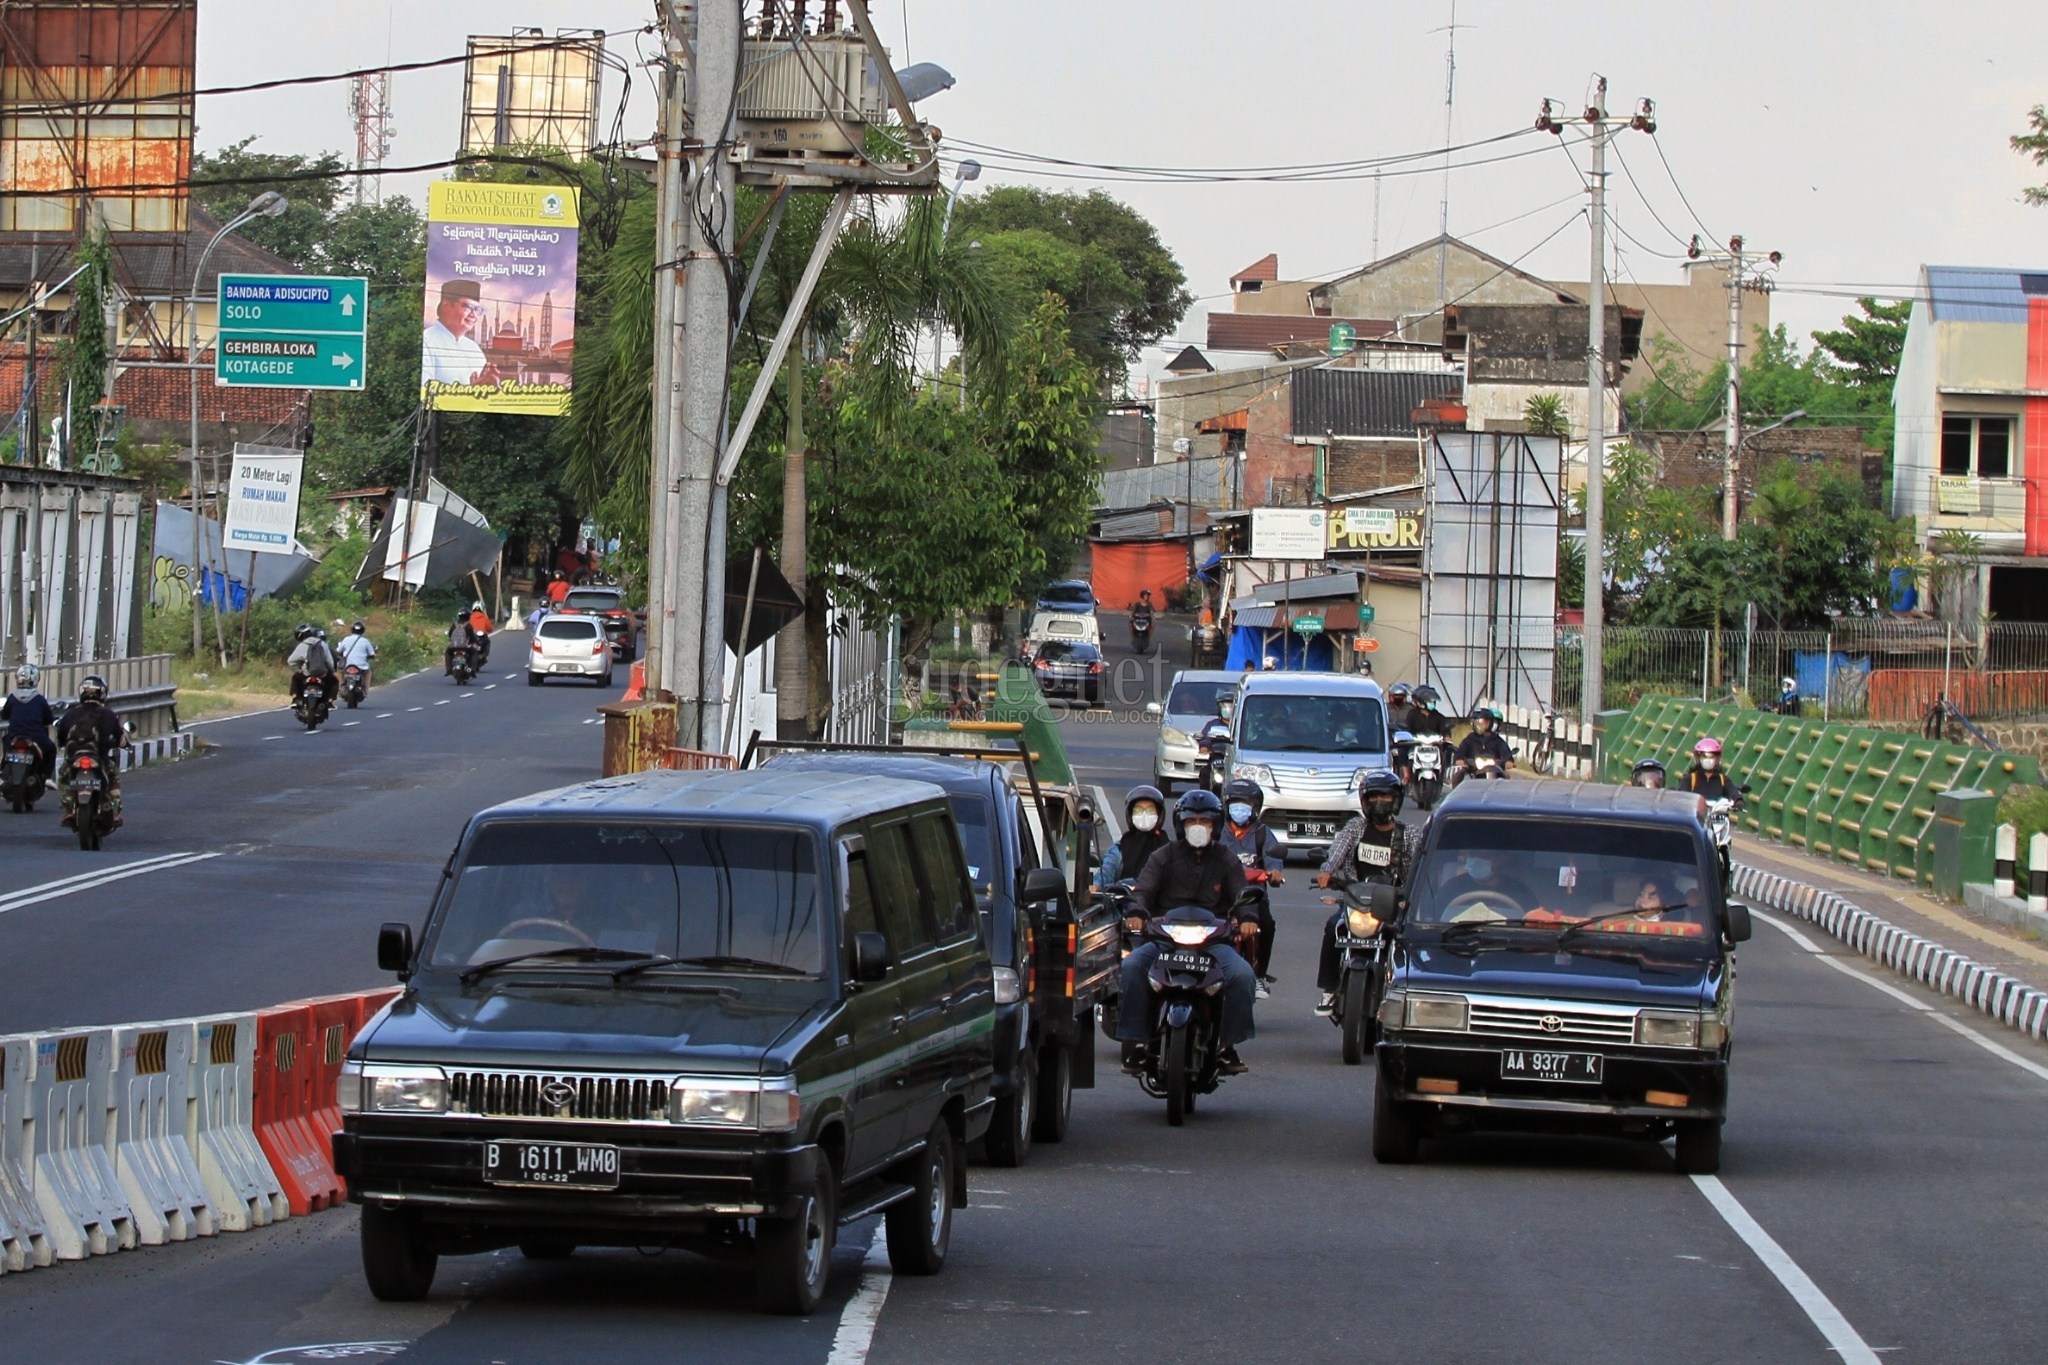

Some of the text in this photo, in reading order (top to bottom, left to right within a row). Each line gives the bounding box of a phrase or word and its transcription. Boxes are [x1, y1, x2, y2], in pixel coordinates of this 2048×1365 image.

[774, 128, 787, 142] 160
[446, 187, 537, 206] RAKYAT SEHAT
[445, 203, 535, 218] EKONOMI BANGKIT
[511, 264, 535, 276] 1442
[536, 265, 547, 277] H
[226, 286, 329, 301] BANDARA ADISUCIPTO
[226, 305, 262, 320] SOLO
[225, 341, 316, 356] GEMBIRA LOKA
[225, 360, 294, 375] KOTAGEDE
[426, 379, 567, 399] Airlangga Hartarto
[241, 466, 293, 486] 20 Meter Lagi
[1940, 480, 1969, 488] DIJUAL
[242, 487, 288, 503] RUMAH MAKAN
[230, 501, 254, 522] NASI
[1347, 509, 1359, 518] SMA
[1366, 510, 1377, 518] ABU
[1377, 510, 1394, 519] BAKAR
[1304, 823, 1321, 833] 1592
[1325, 823, 1336, 833] VC
[1361, 847, 1372, 858] NO
[1158, 953, 1169, 961] AB
[1199, 956, 1211, 965] DJ
[1506, 1051, 1597, 1074] AA 9377 K
[487, 1143, 500, 1168] B
[519, 1145, 563, 1171] 1611
